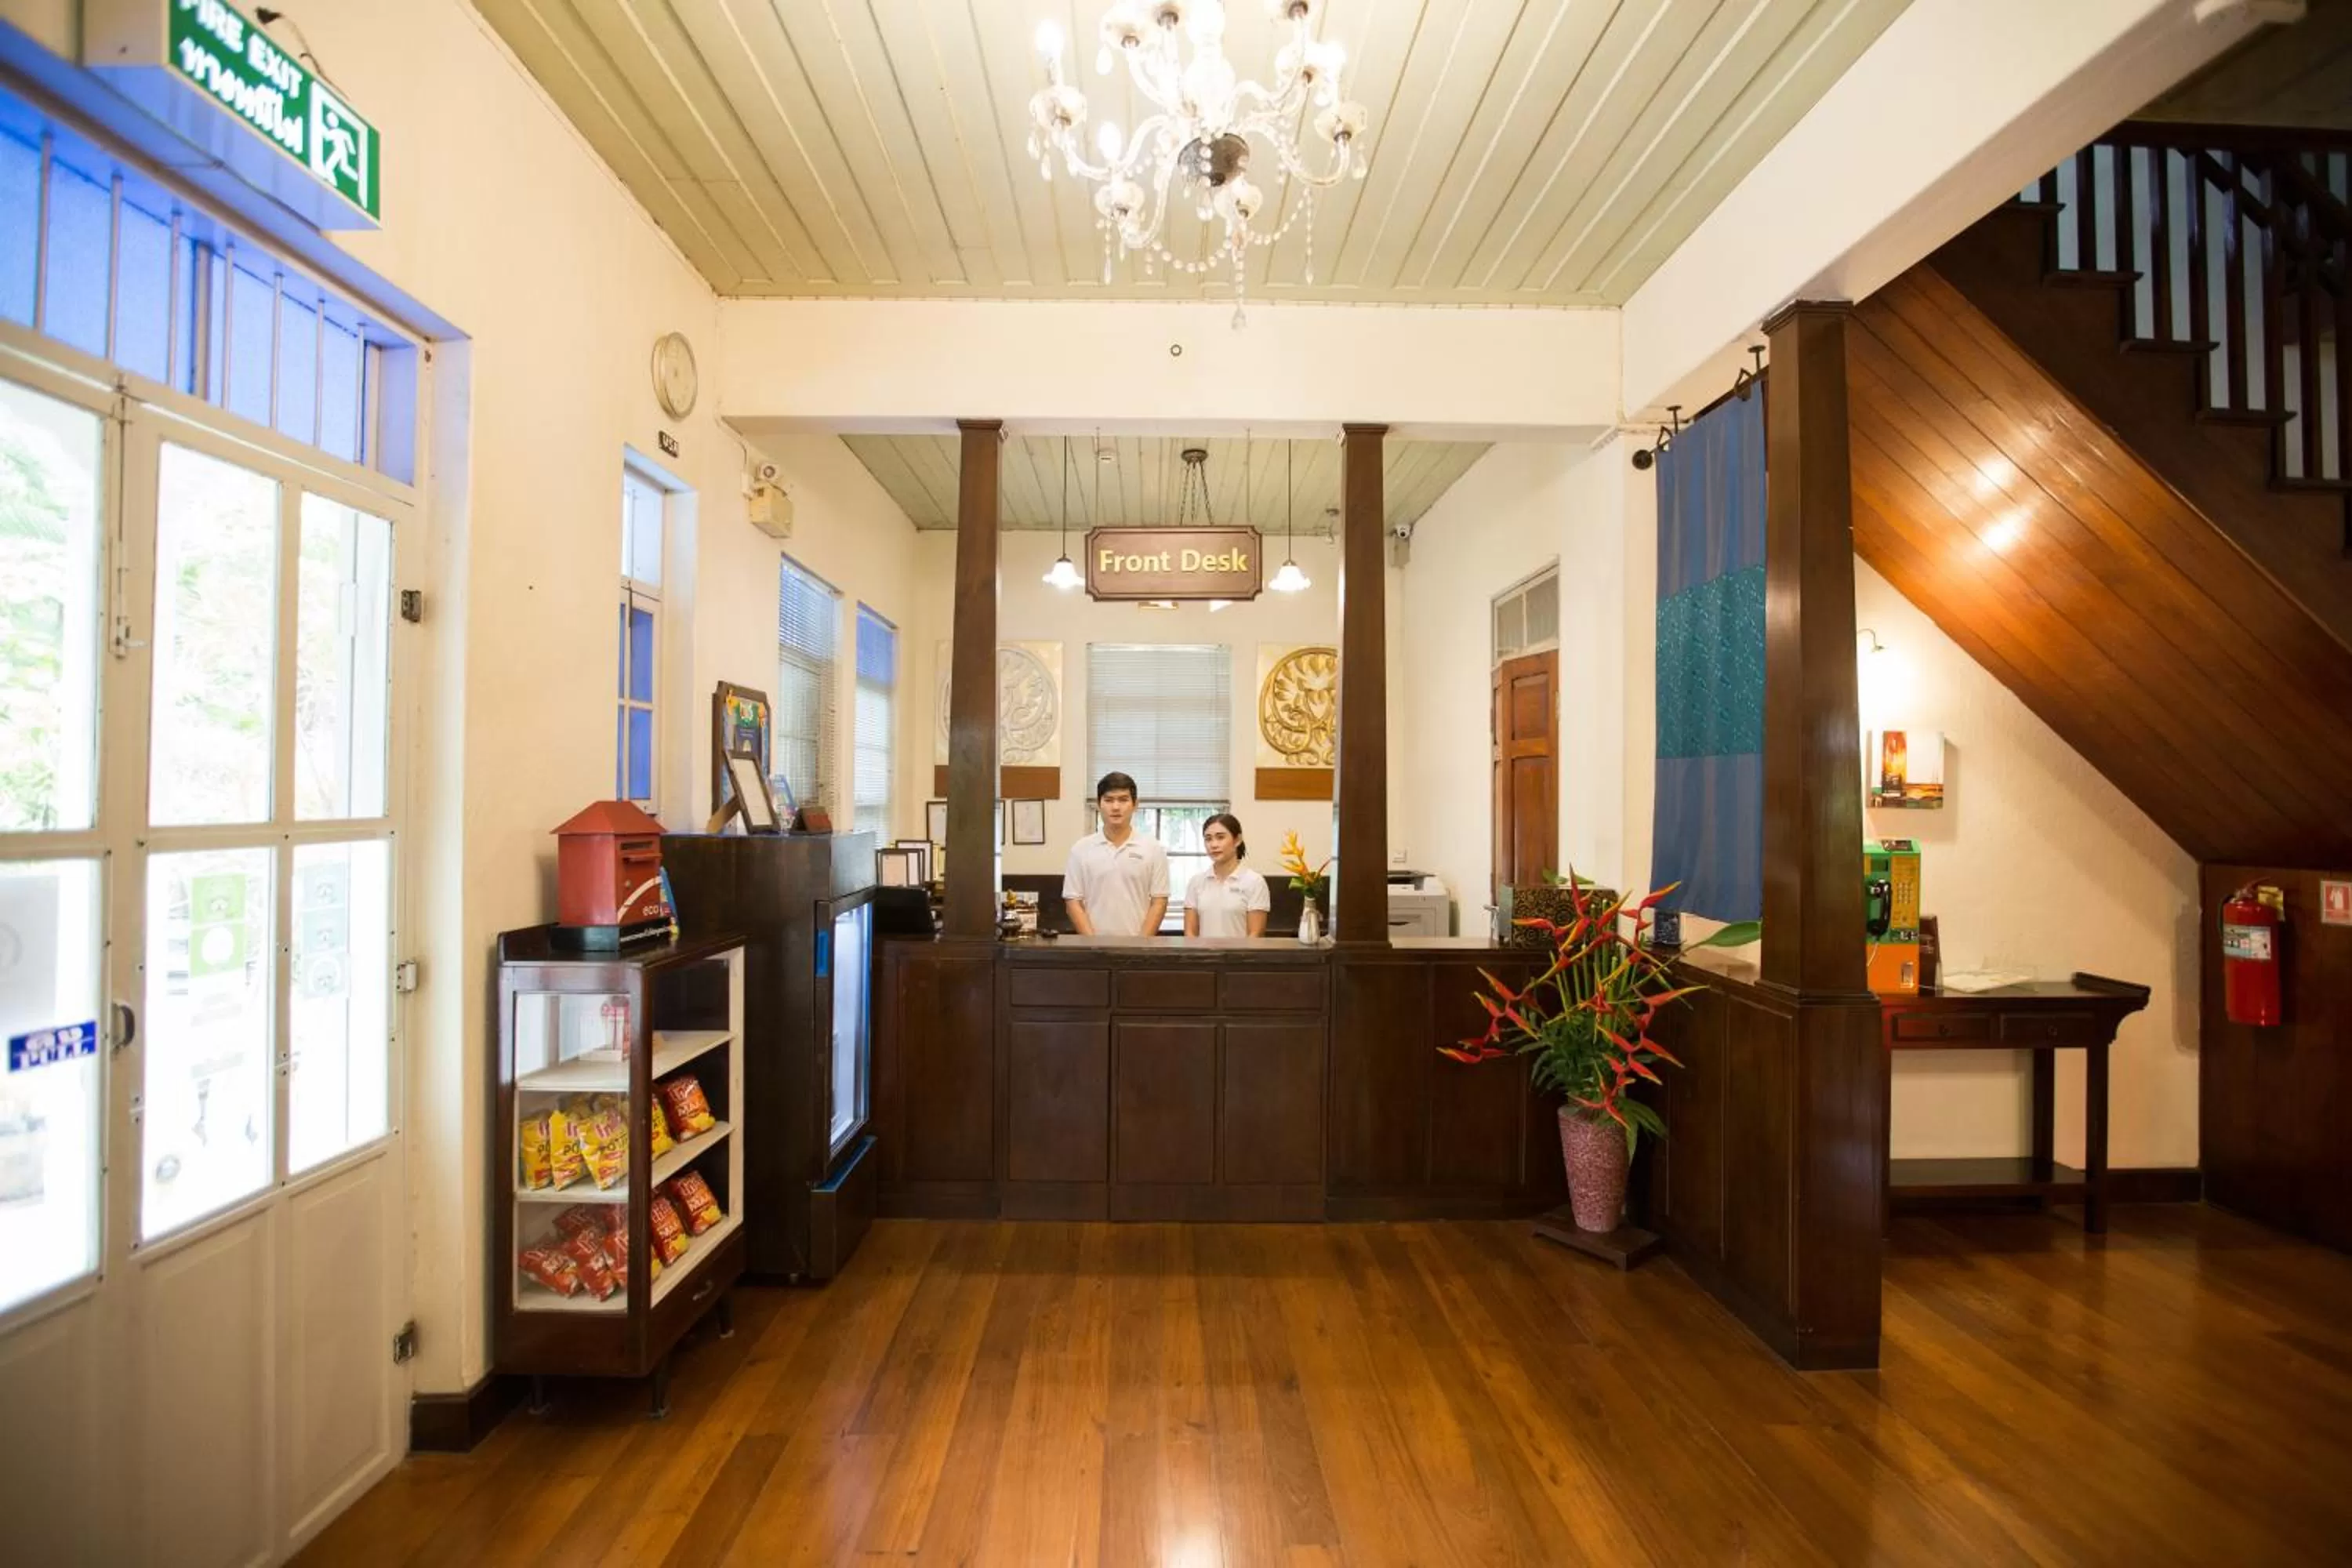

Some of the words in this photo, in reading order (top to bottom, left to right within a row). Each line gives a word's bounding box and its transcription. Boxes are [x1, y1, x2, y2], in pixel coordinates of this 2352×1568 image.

[247, 32, 303, 99] EXIT
[1099, 550, 1171, 572] Front
[1181, 548, 1248, 572] Desk
